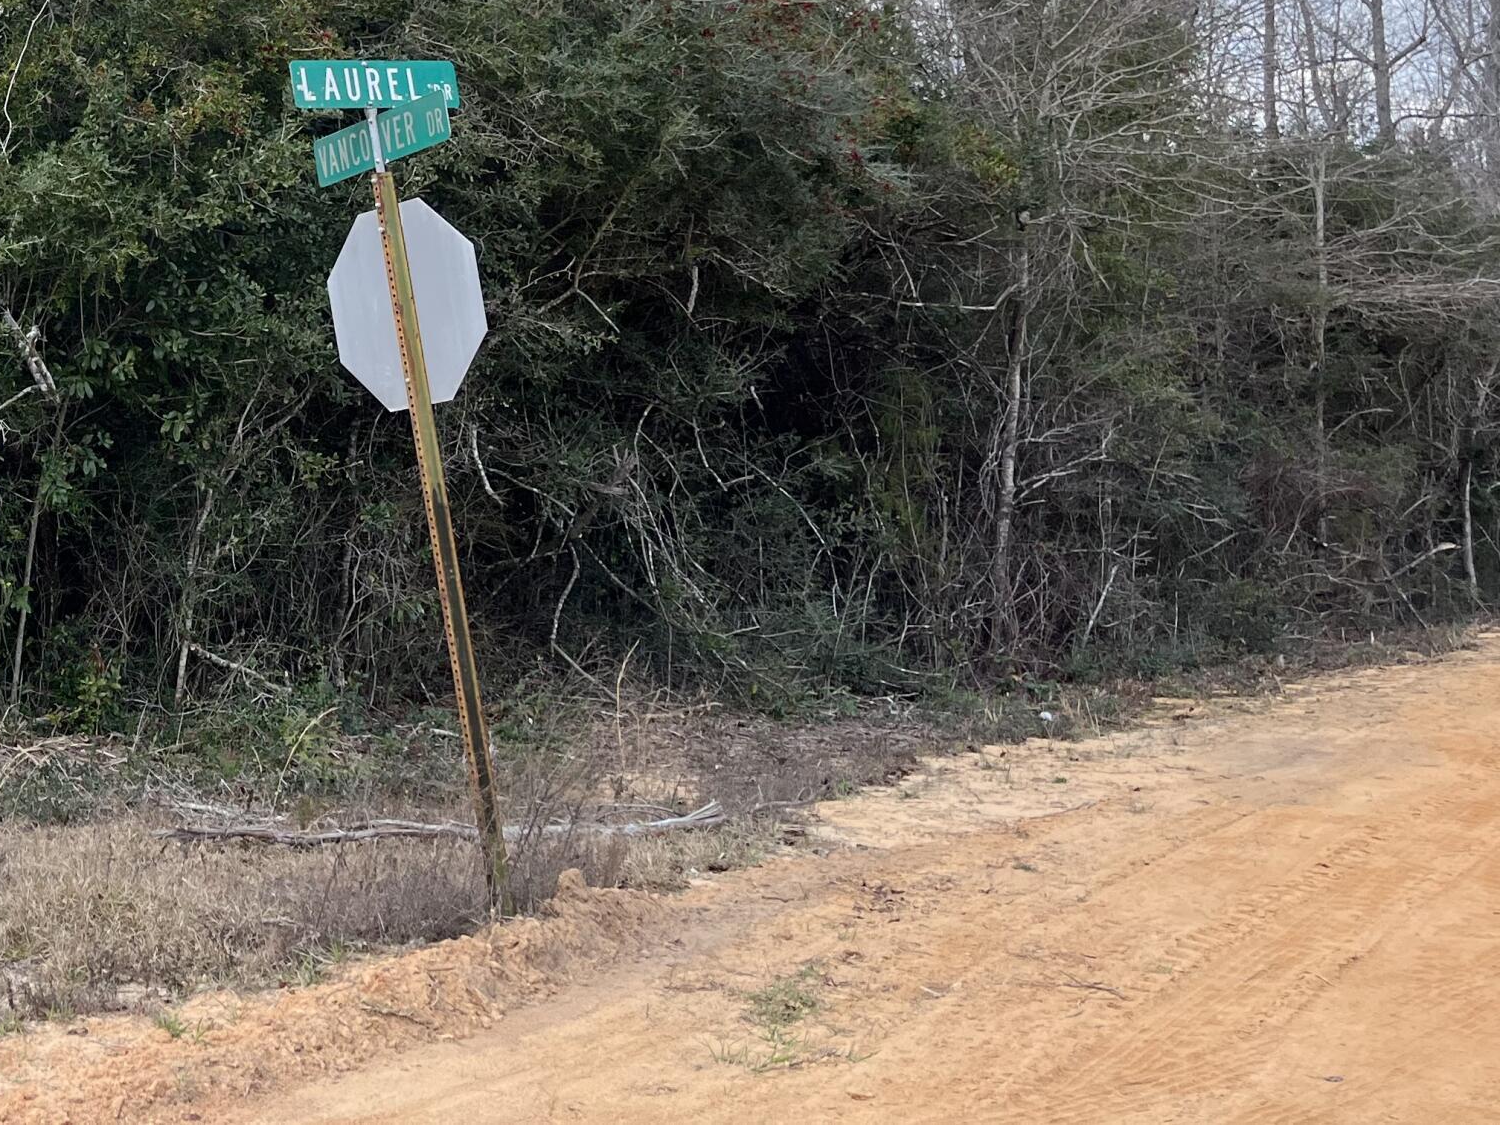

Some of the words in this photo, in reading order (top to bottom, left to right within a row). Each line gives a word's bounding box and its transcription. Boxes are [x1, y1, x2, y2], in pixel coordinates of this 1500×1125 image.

[299, 67, 422, 101] LAUREL
[318, 111, 417, 178] VANCOVER
[426, 107, 445, 137] DR
